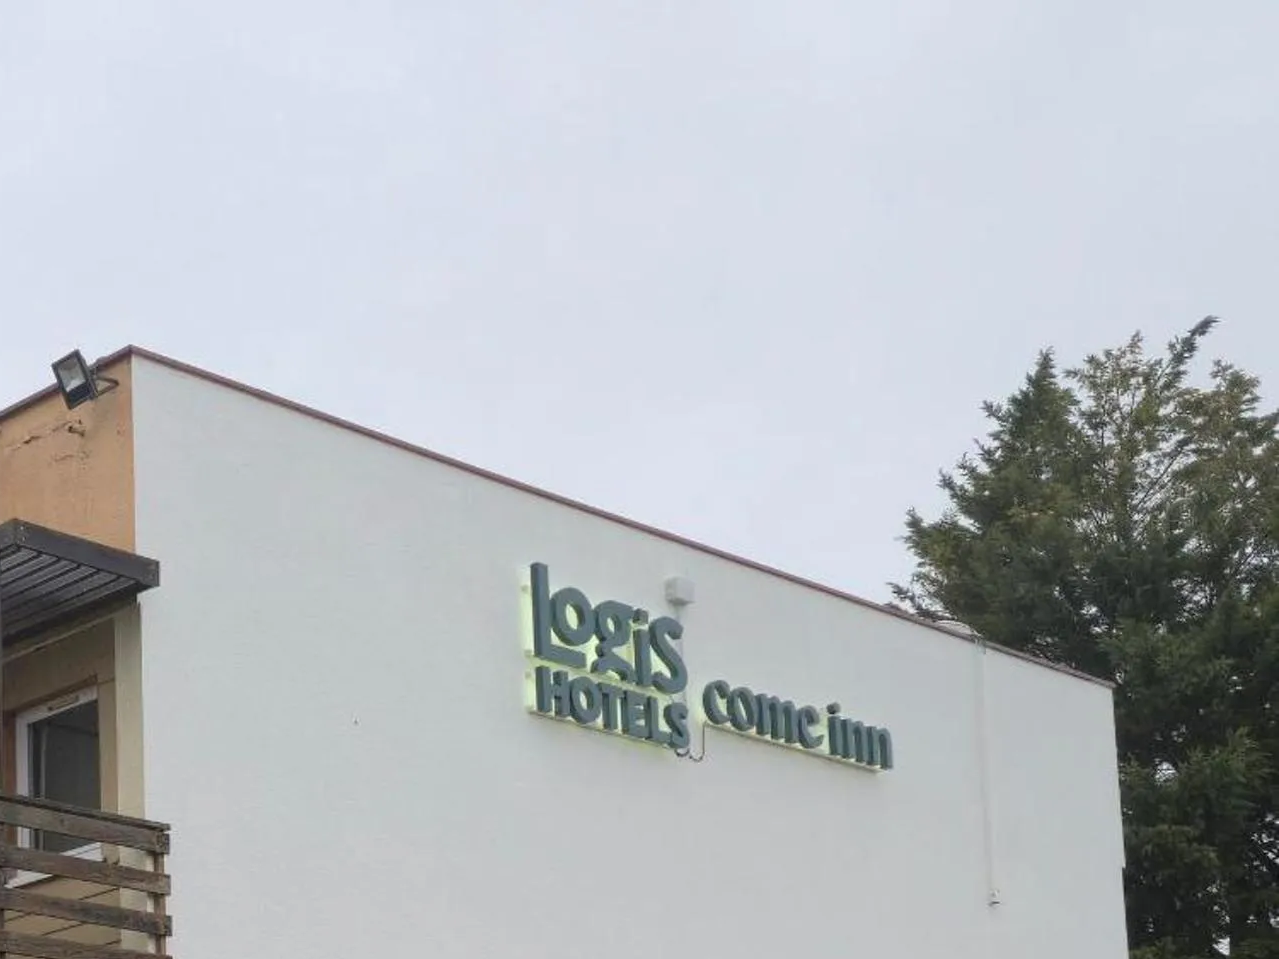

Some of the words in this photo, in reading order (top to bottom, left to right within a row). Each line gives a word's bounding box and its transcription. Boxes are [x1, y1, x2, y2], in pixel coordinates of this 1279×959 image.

[534, 665, 690, 750] HOTELS
[701, 679, 823, 750] come
[826, 702, 894, 770] inn
